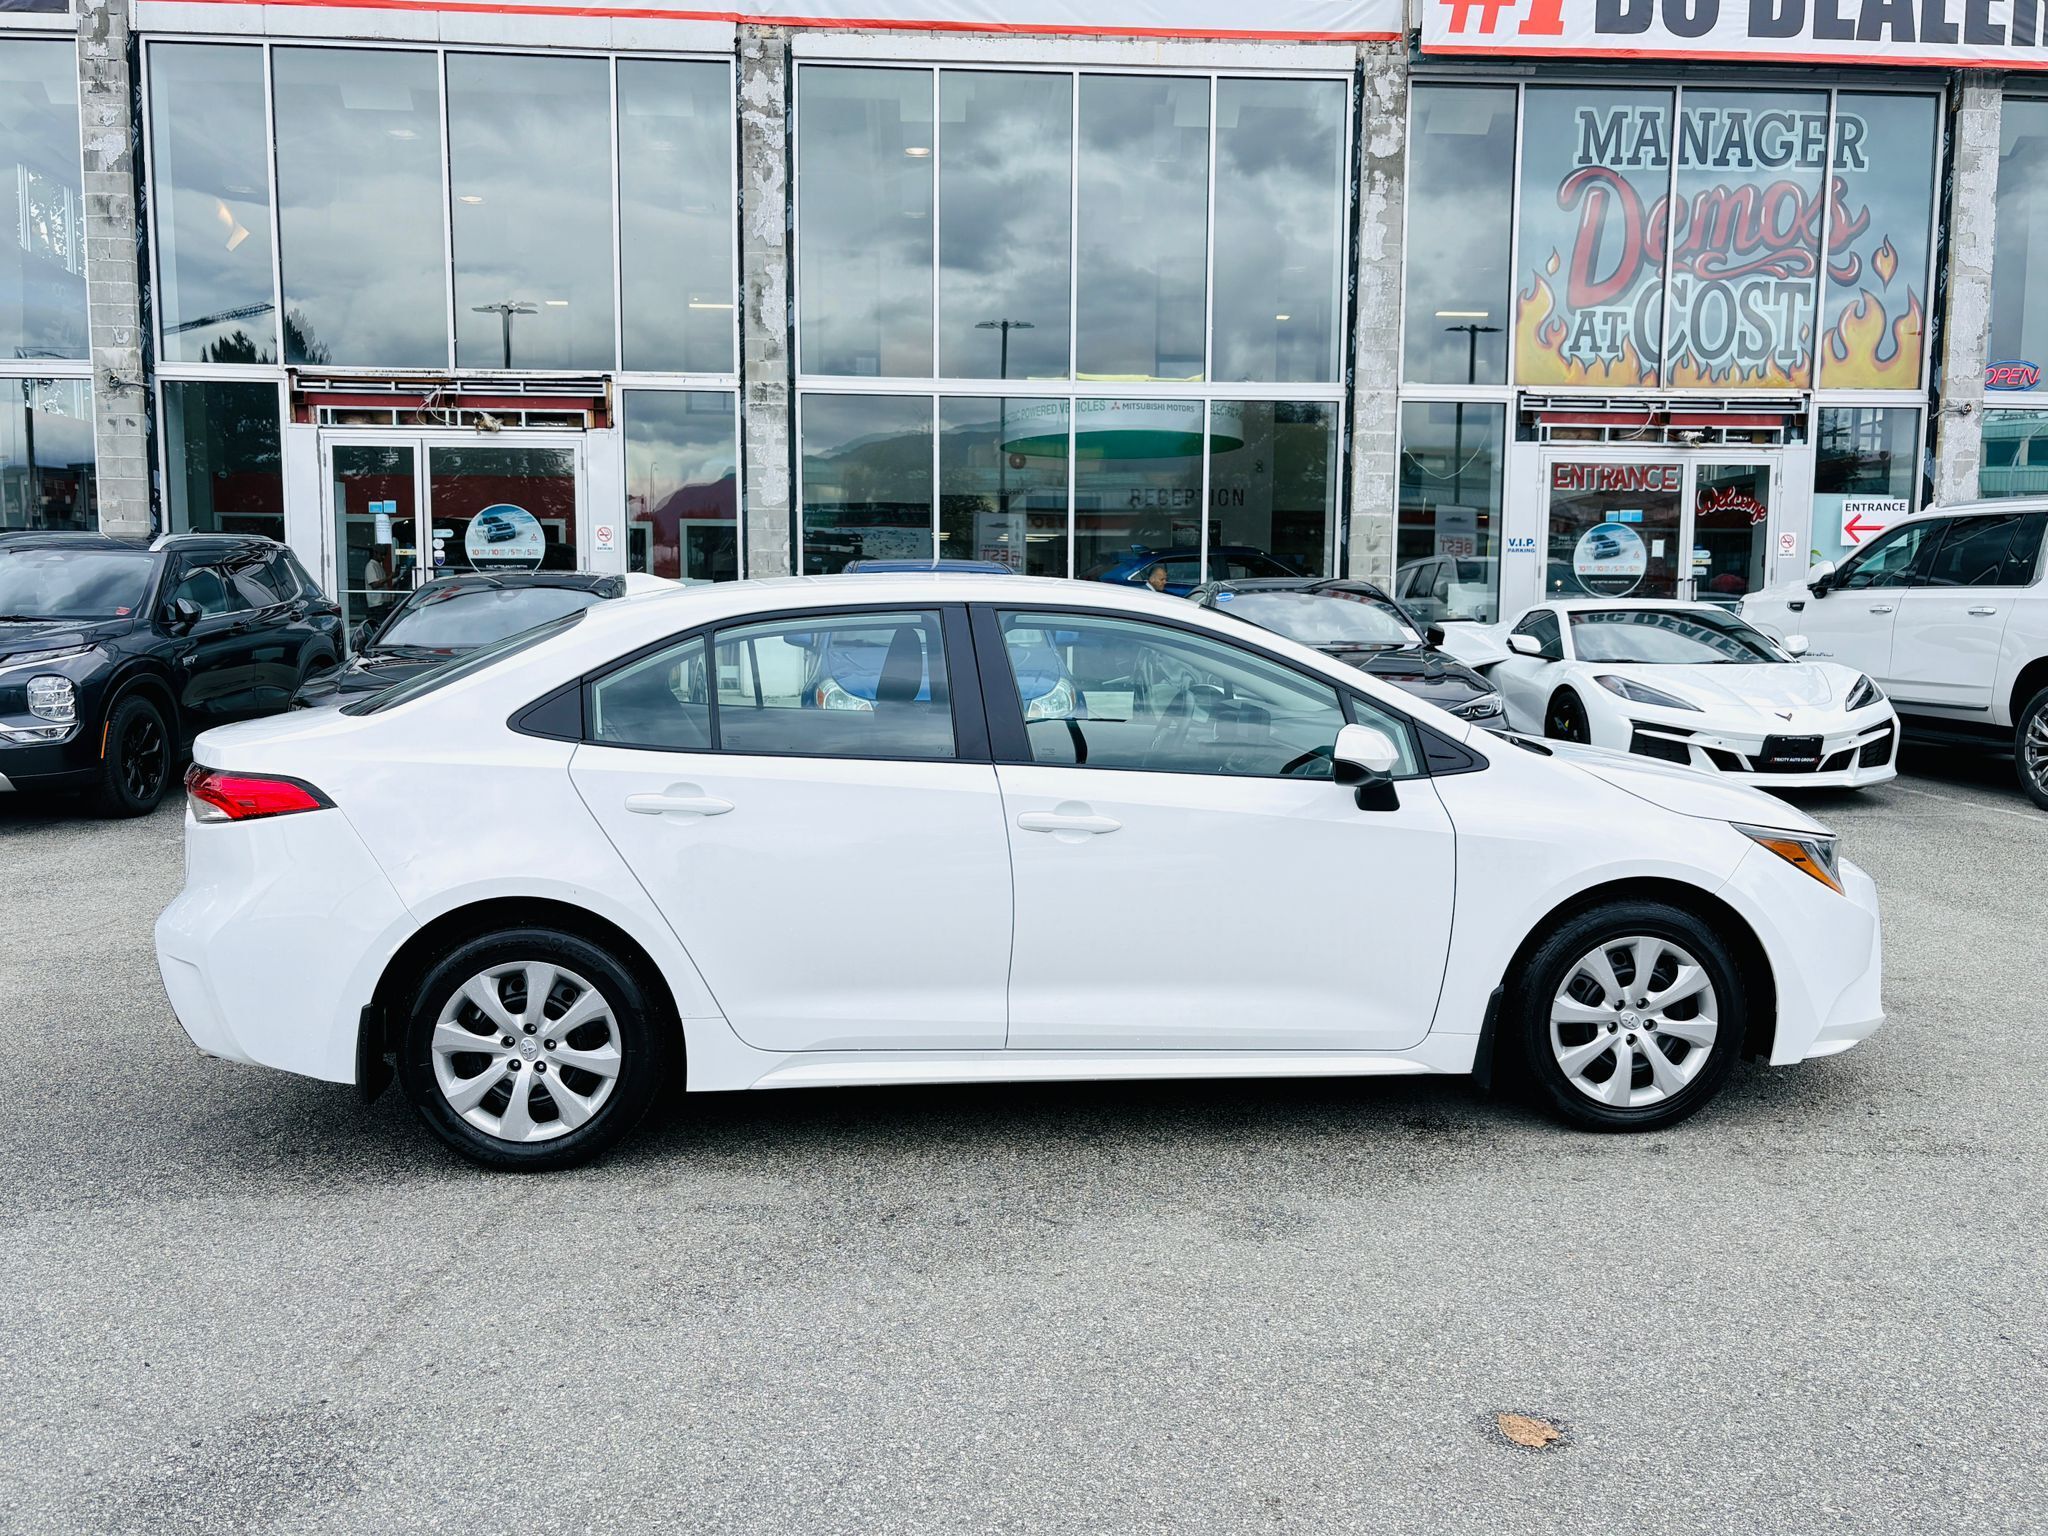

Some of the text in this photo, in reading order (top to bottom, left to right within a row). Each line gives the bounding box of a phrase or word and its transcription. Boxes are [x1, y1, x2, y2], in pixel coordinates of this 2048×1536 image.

[1575, 108, 1867, 170] MANAGER
[1557, 166, 1870, 312] Demos
[1568, 279, 1812, 363] AT COST
[1122, 402, 1195, 413] MITSUBISHI MOTORS
[1553, 464, 1680, 492] ENTRANCE
[1696, 486, 1767, 526] Welcome
[1845, 502, 1906, 512] ENTRANCE
[1508, 538, 1536, 547] V.I.P.
